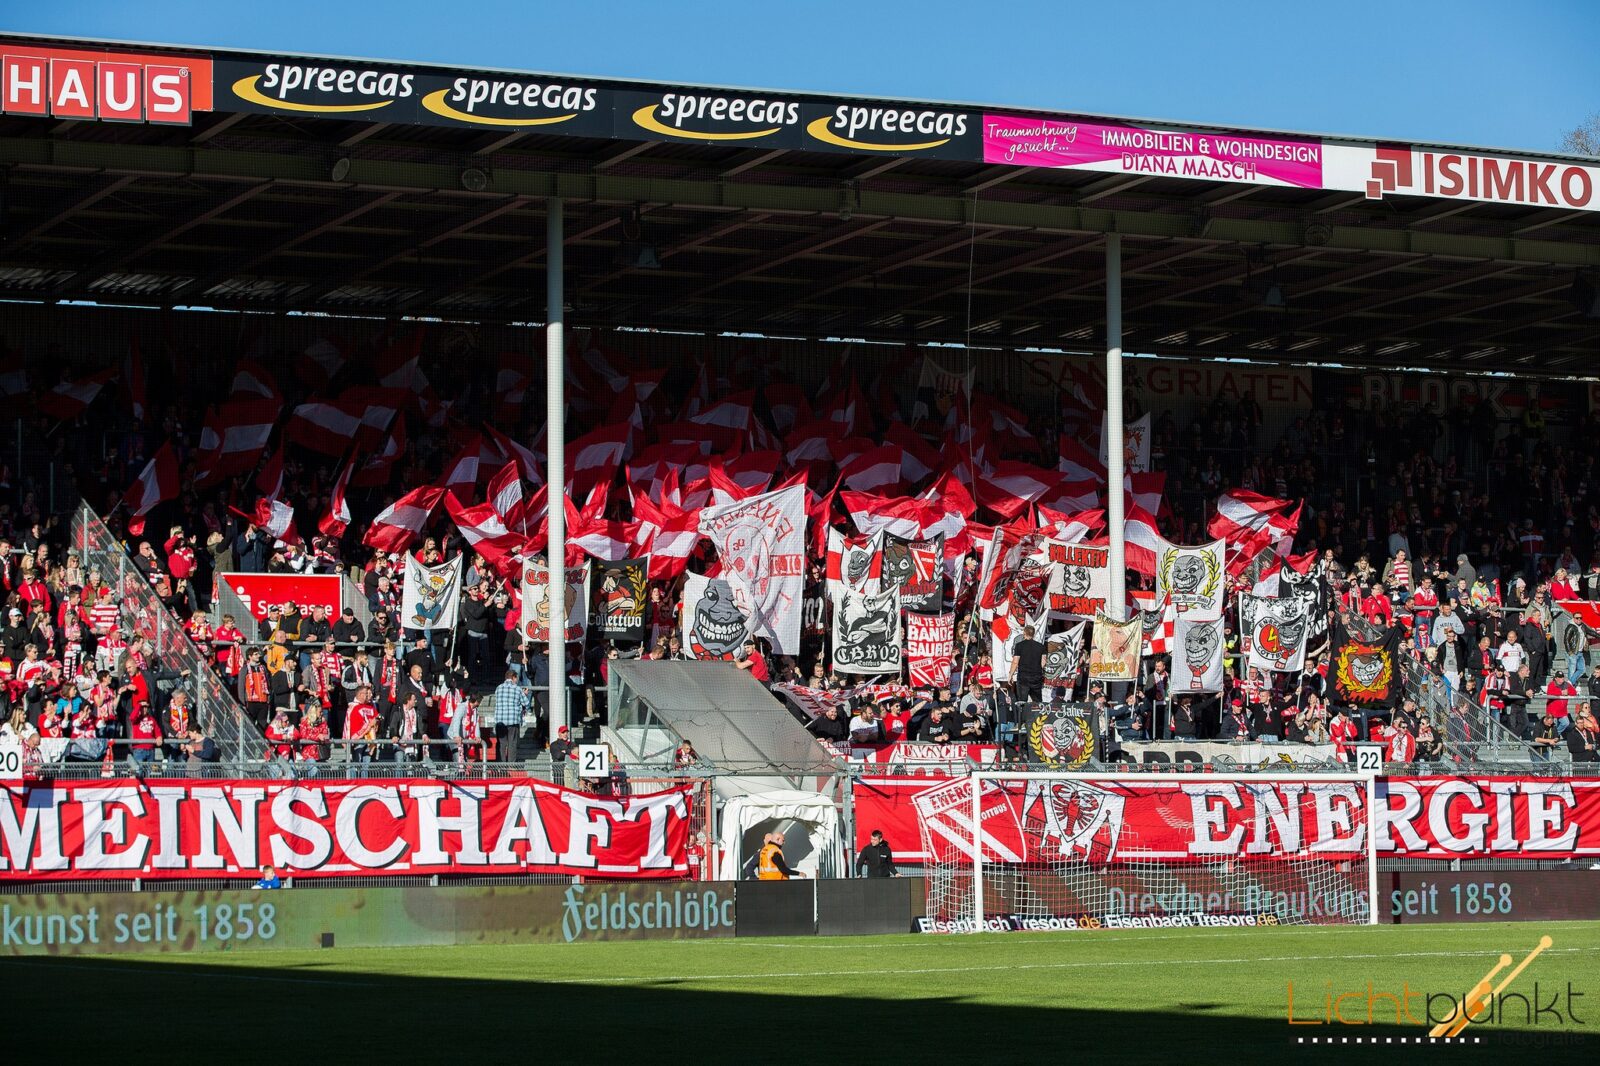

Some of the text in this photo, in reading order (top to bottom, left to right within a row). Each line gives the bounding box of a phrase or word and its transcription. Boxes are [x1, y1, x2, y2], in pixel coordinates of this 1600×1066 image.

[987, 121, 1078, 144] Traumwohnung
[1004, 140, 1070, 161] gesucht...
[1101, 130, 1319, 163] IMMOBILIEN & WOHNDESIGN
[1122, 152, 1256, 180] DIANA MAASCH
[1424, 153, 1593, 208] ISIMKO
[1049, 543, 1109, 568] KOLLEKTIV
[908, 613, 934, 627] HALTE
[907, 625, 954, 643] BANDE
[585, 751, 605, 771] 21
[1360, 751, 1379, 770] 22
[1181, 780, 1581, 855] ENERGIE
[1245, 881, 1369, 918] Braukuns
[1391, 883, 1438, 916] seit
[1450, 882, 1513, 915] 1858
[2, 902, 277, 945] kunst seit 1858
